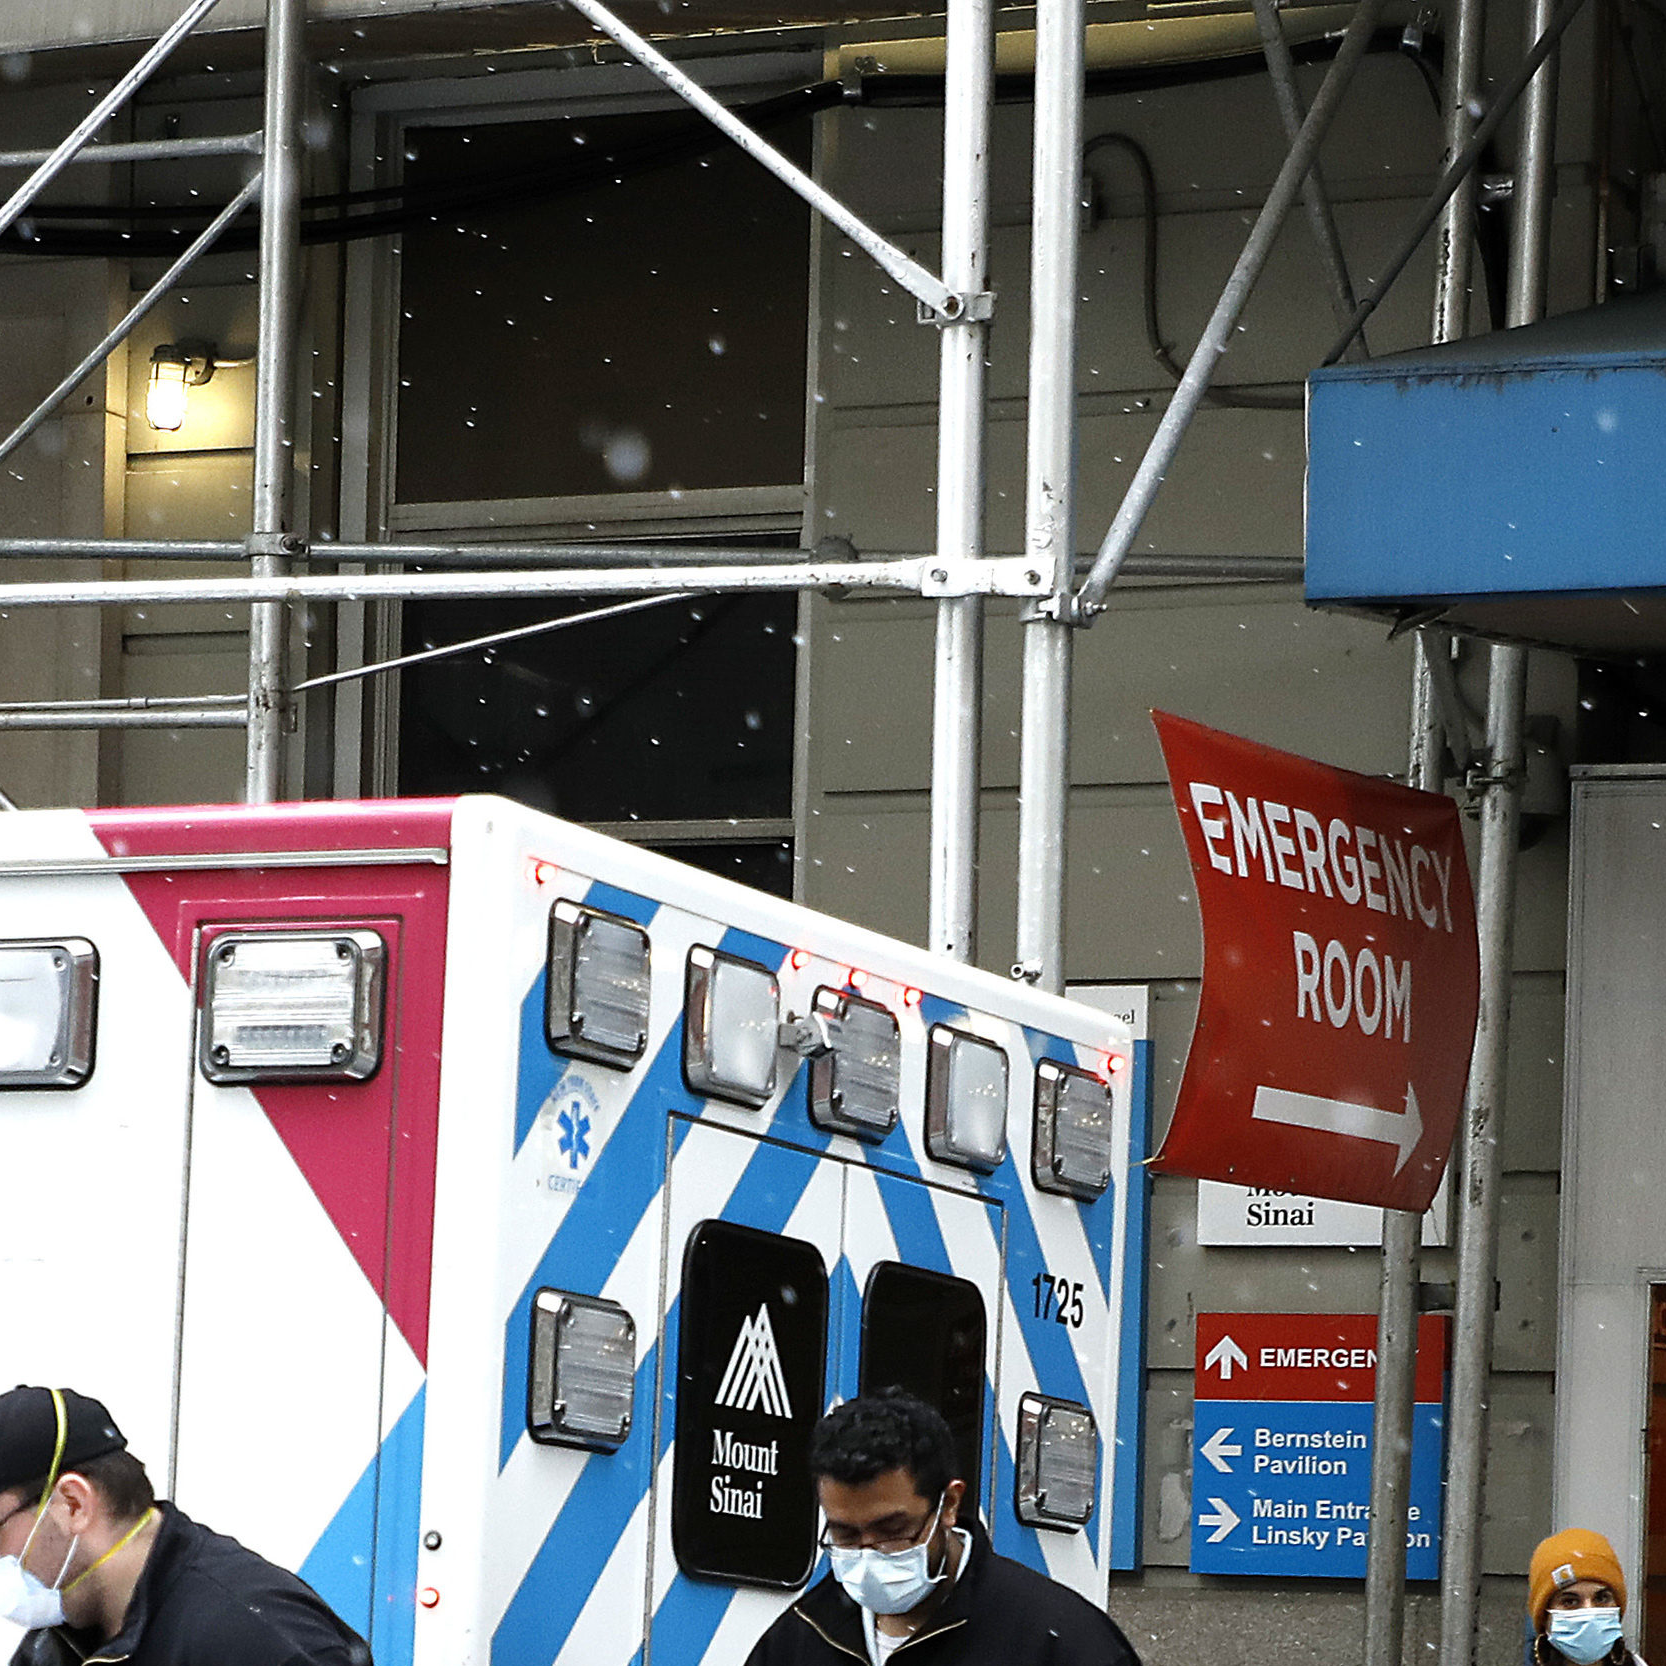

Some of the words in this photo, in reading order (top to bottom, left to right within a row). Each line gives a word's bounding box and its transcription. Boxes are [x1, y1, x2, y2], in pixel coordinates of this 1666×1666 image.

[1188, 781, 1453, 933] EMERGENCY
[1293, 930, 1412, 1044] ROOM
[1246, 1203, 1315, 1227] Sinai
[1032, 1272, 1084, 1329] 1725
[1259, 1348, 1379, 1369] EMERGEN
[1254, 1429, 1367, 1450] Bernstein
[711, 1429, 779, 1476] Mount
[1253, 1455, 1348, 1476] Pavilion
[710, 1474, 763, 1519] Sinai
[1252, 1500, 1308, 1520] Main
[1252, 1526, 1329, 1549] Linsky
